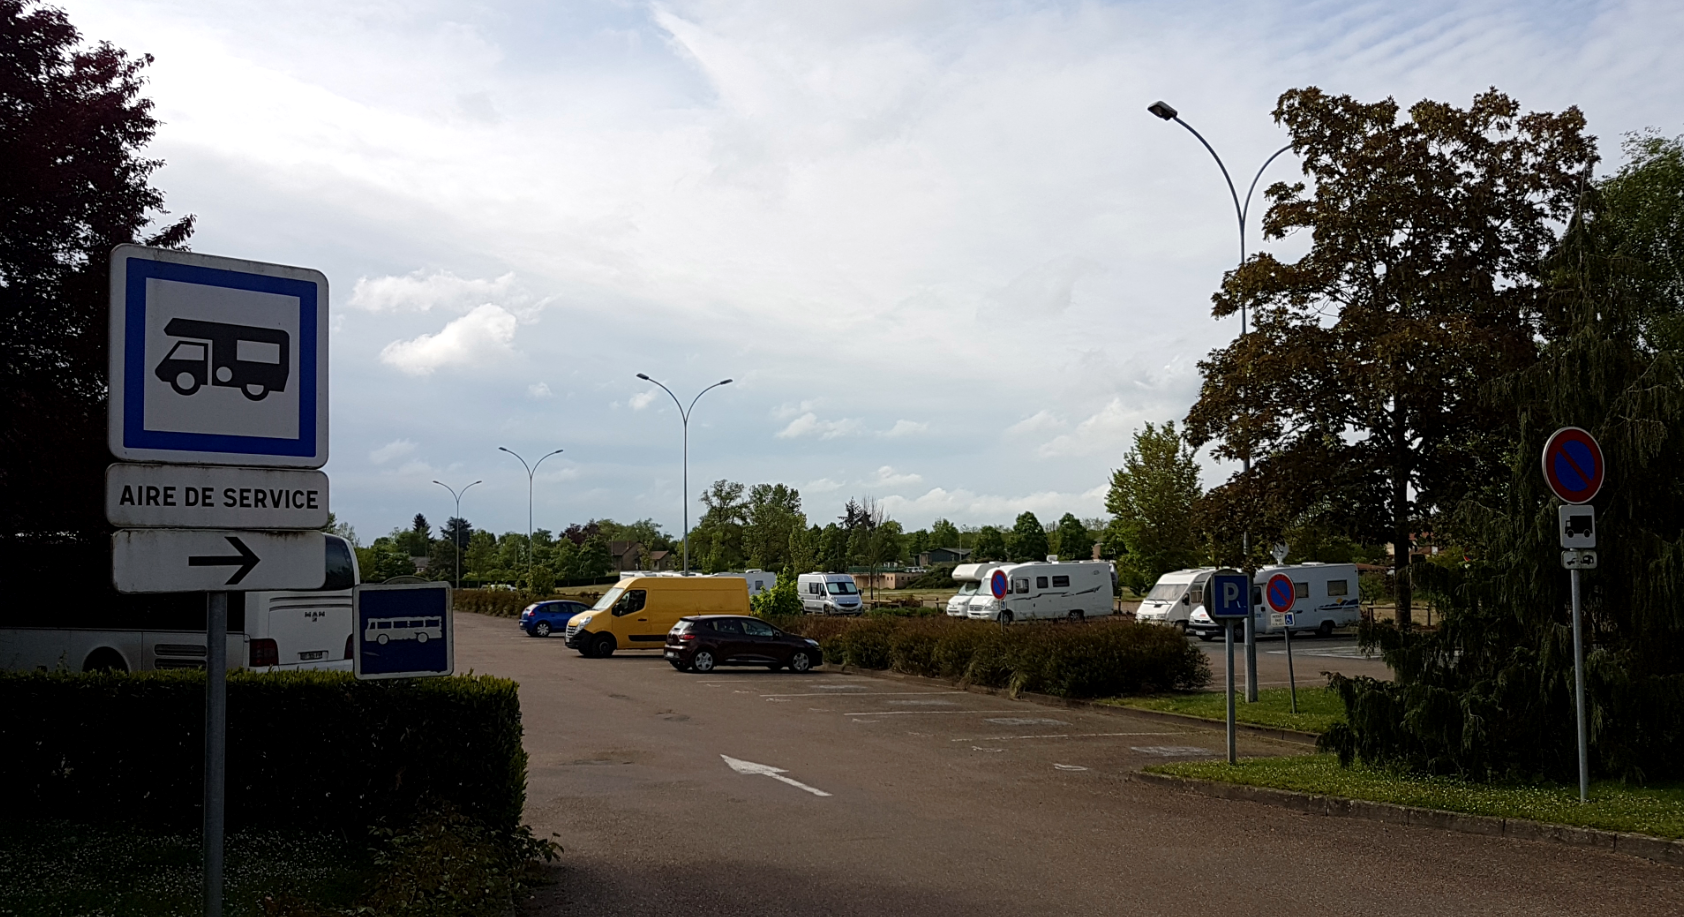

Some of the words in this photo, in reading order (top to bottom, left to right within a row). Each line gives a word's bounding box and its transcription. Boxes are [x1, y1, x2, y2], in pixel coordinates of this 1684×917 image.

[119, 485, 177, 507] AIRE
[185, 487, 215, 508] DE
[223, 488, 319, 509] SERVICE
[1223, 582, 1239, 608] P
